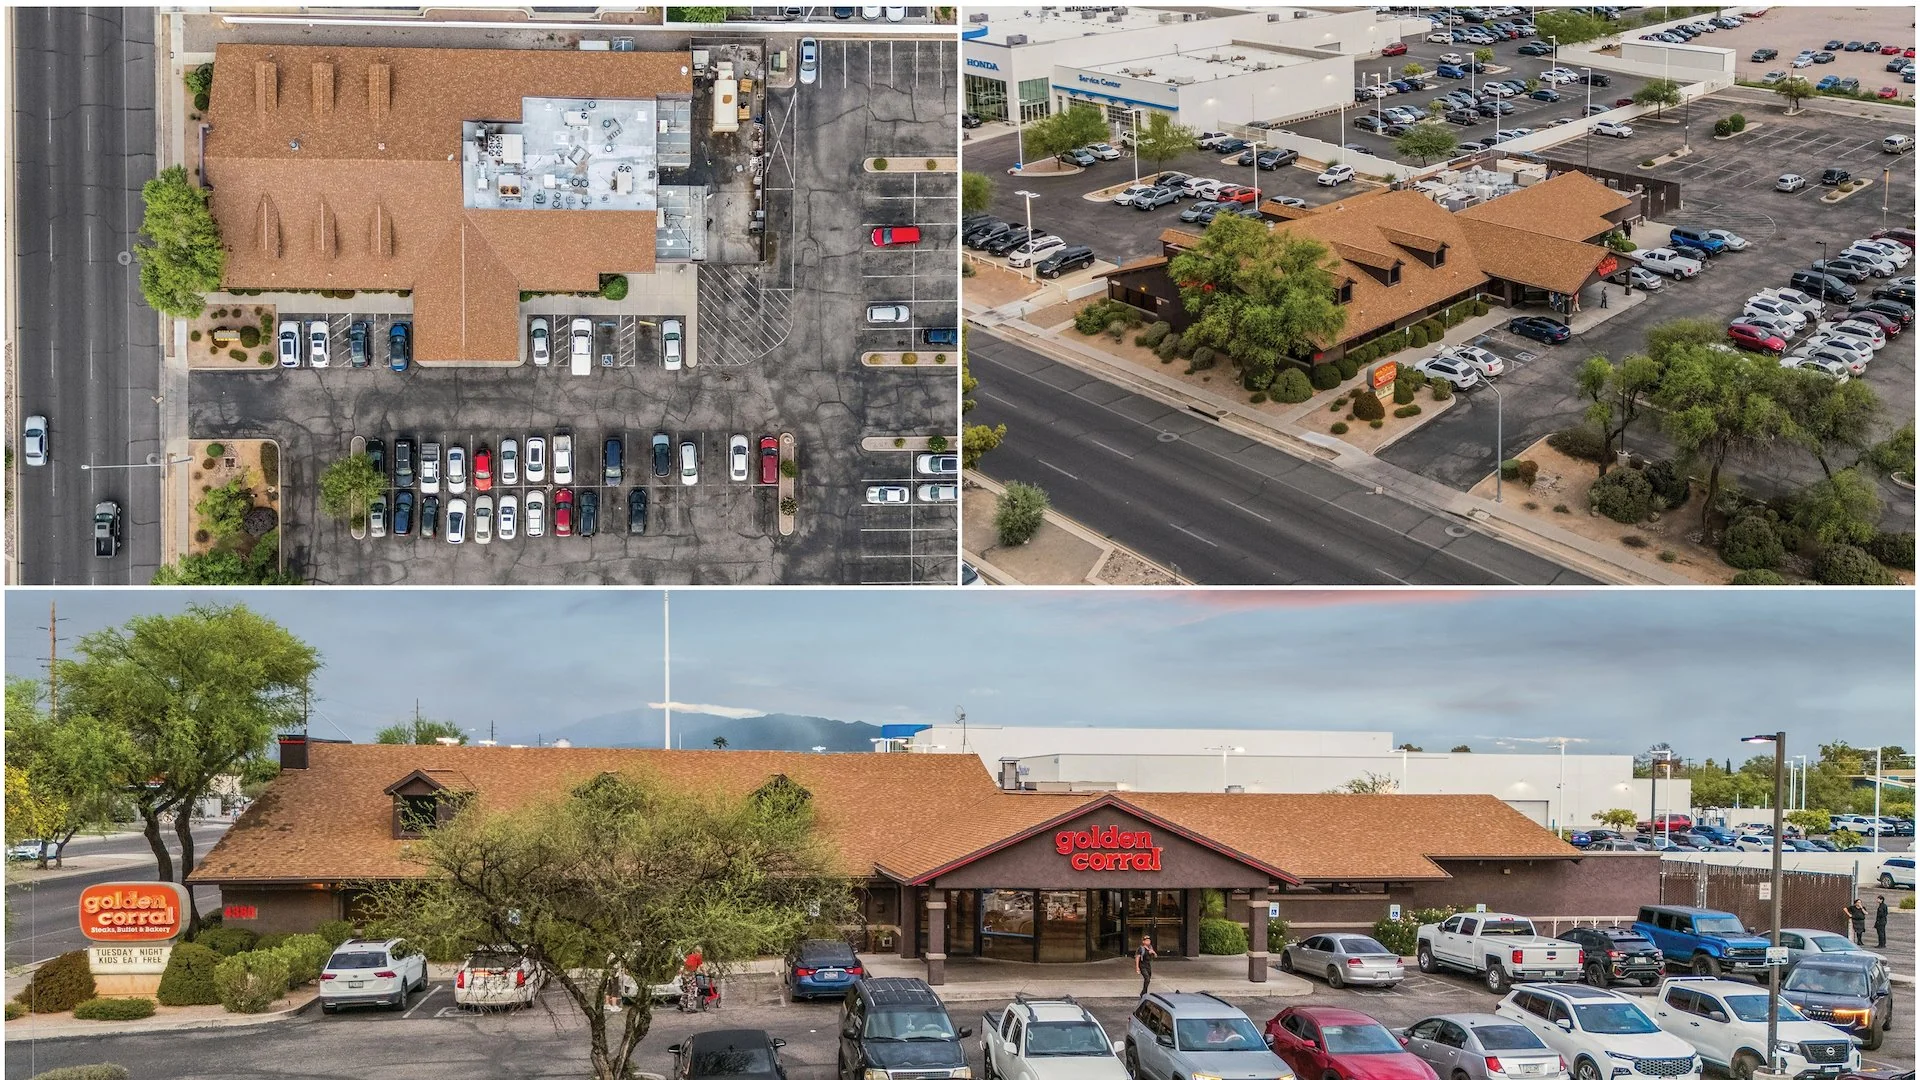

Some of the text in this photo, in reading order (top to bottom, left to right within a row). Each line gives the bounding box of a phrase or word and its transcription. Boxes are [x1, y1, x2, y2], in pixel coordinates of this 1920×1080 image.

[966, 58, 1000, 71] HONDA
[1079, 74, 1122, 88] Service Center
[1055, 825, 1153, 855] golden
[1071, 847, 1162, 871] corral
[84, 891, 167, 914] golden
[98, 906, 175, 926] corral
[145, 926, 171, 934] Bakery
[96, 948, 164, 957] TUESDAY NIGHT
[98, 956, 162, 964] KIDS EAT FREE
